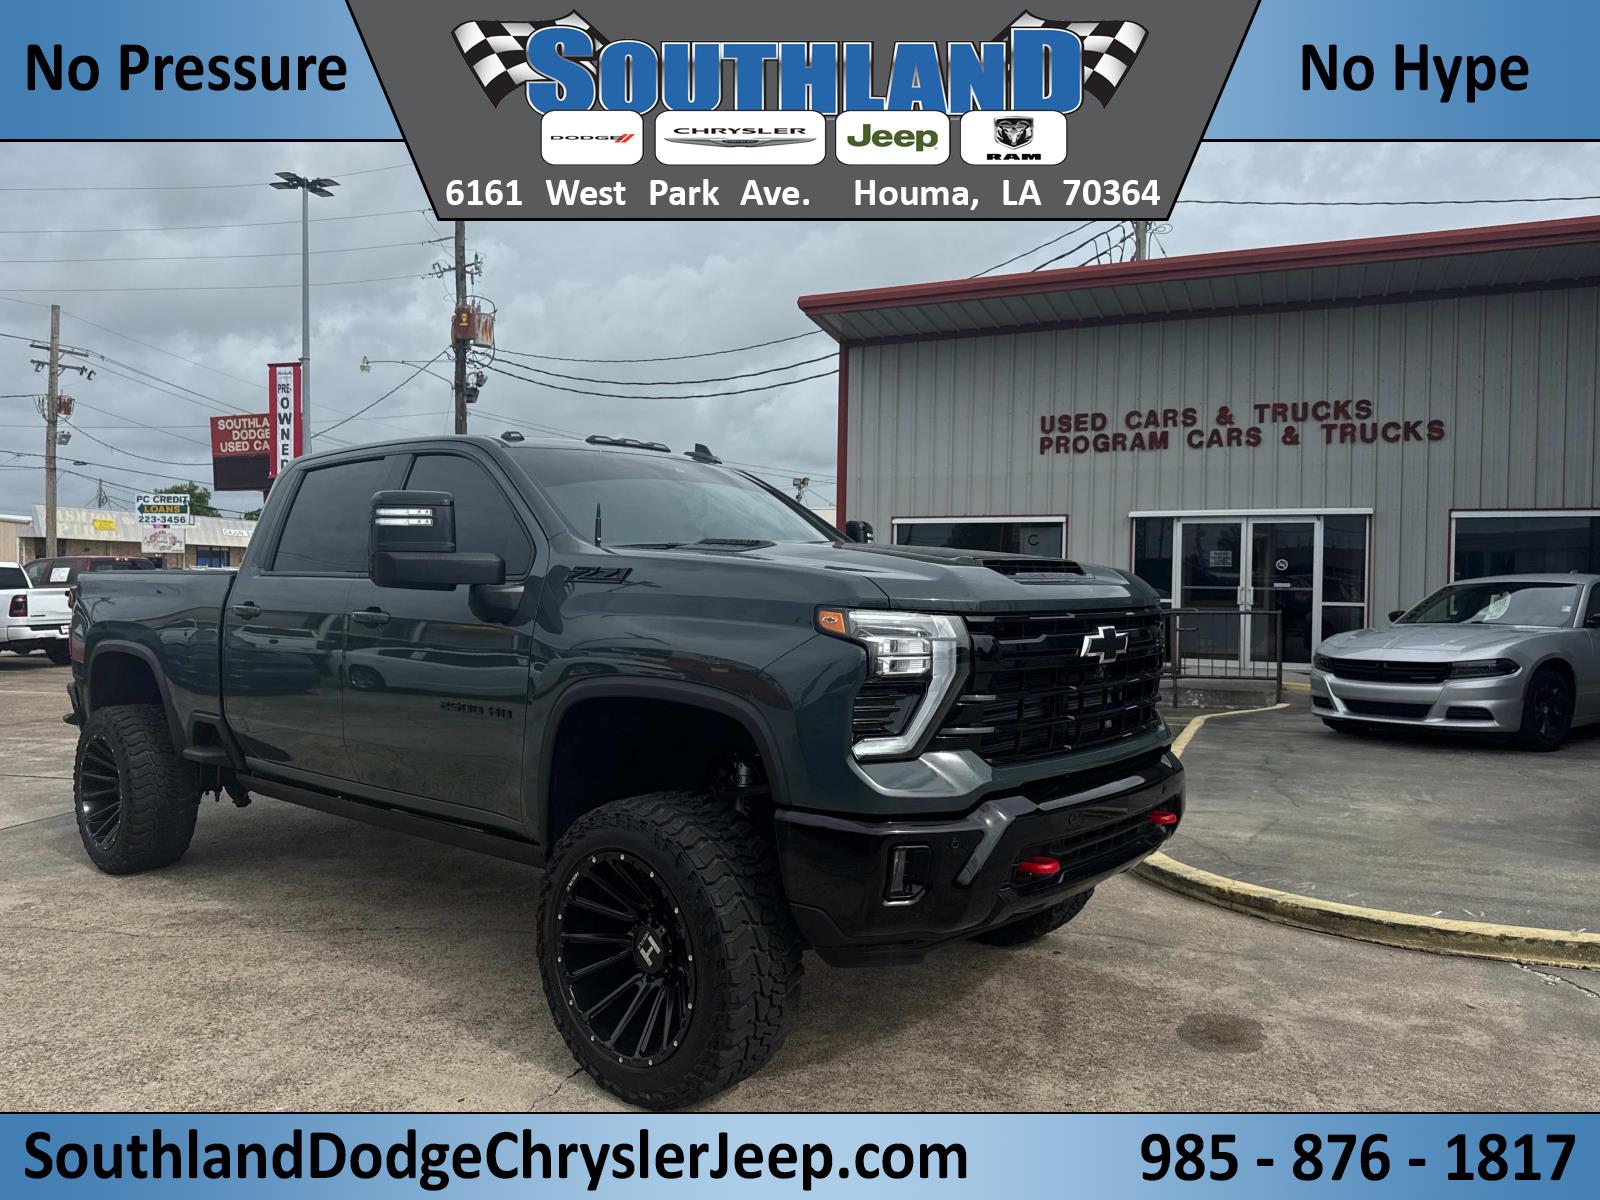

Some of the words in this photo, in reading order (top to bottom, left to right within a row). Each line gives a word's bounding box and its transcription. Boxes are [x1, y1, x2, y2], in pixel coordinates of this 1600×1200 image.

[1040, 412, 1107, 434] USED
[1125, 407, 1197, 430] CARS
[1215, 405, 1235, 426] &
[1253, 399, 1373, 424] TRUCKS
[1039, 430, 1170, 455] PROGRAM
[1186, 426, 1262, 450] CARS
[1281, 425, 1301, 446] &
[1320, 419, 1446, 445] TRUCKS
[219, 441, 250, 453] USED
[136, 495, 150, 504] PC
[153, 495, 188, 504] CREDIT
[143, 505, 181, 513] LOANS
[138, 515, 187, 524] 223-3456
